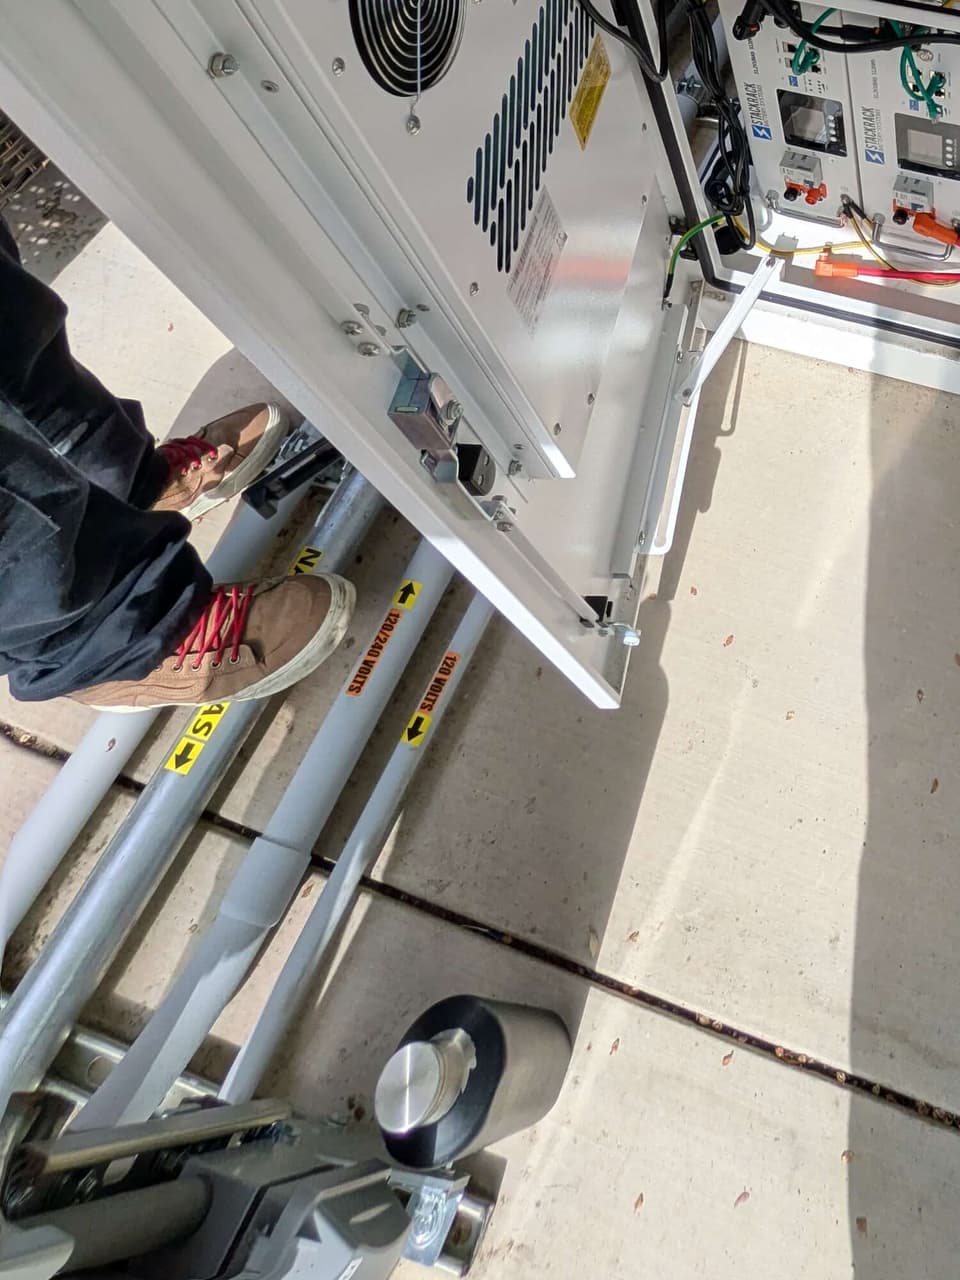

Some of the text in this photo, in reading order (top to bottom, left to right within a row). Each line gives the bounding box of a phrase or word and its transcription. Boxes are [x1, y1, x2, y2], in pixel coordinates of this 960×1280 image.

[744, 81, 764, 126] STACKRACK
[862, 106, 877, 150] STACKRACK
[348, 611, 400, 694] 120/240 VOLTS
[421, 655, 457, 712] 120 VOLTS
